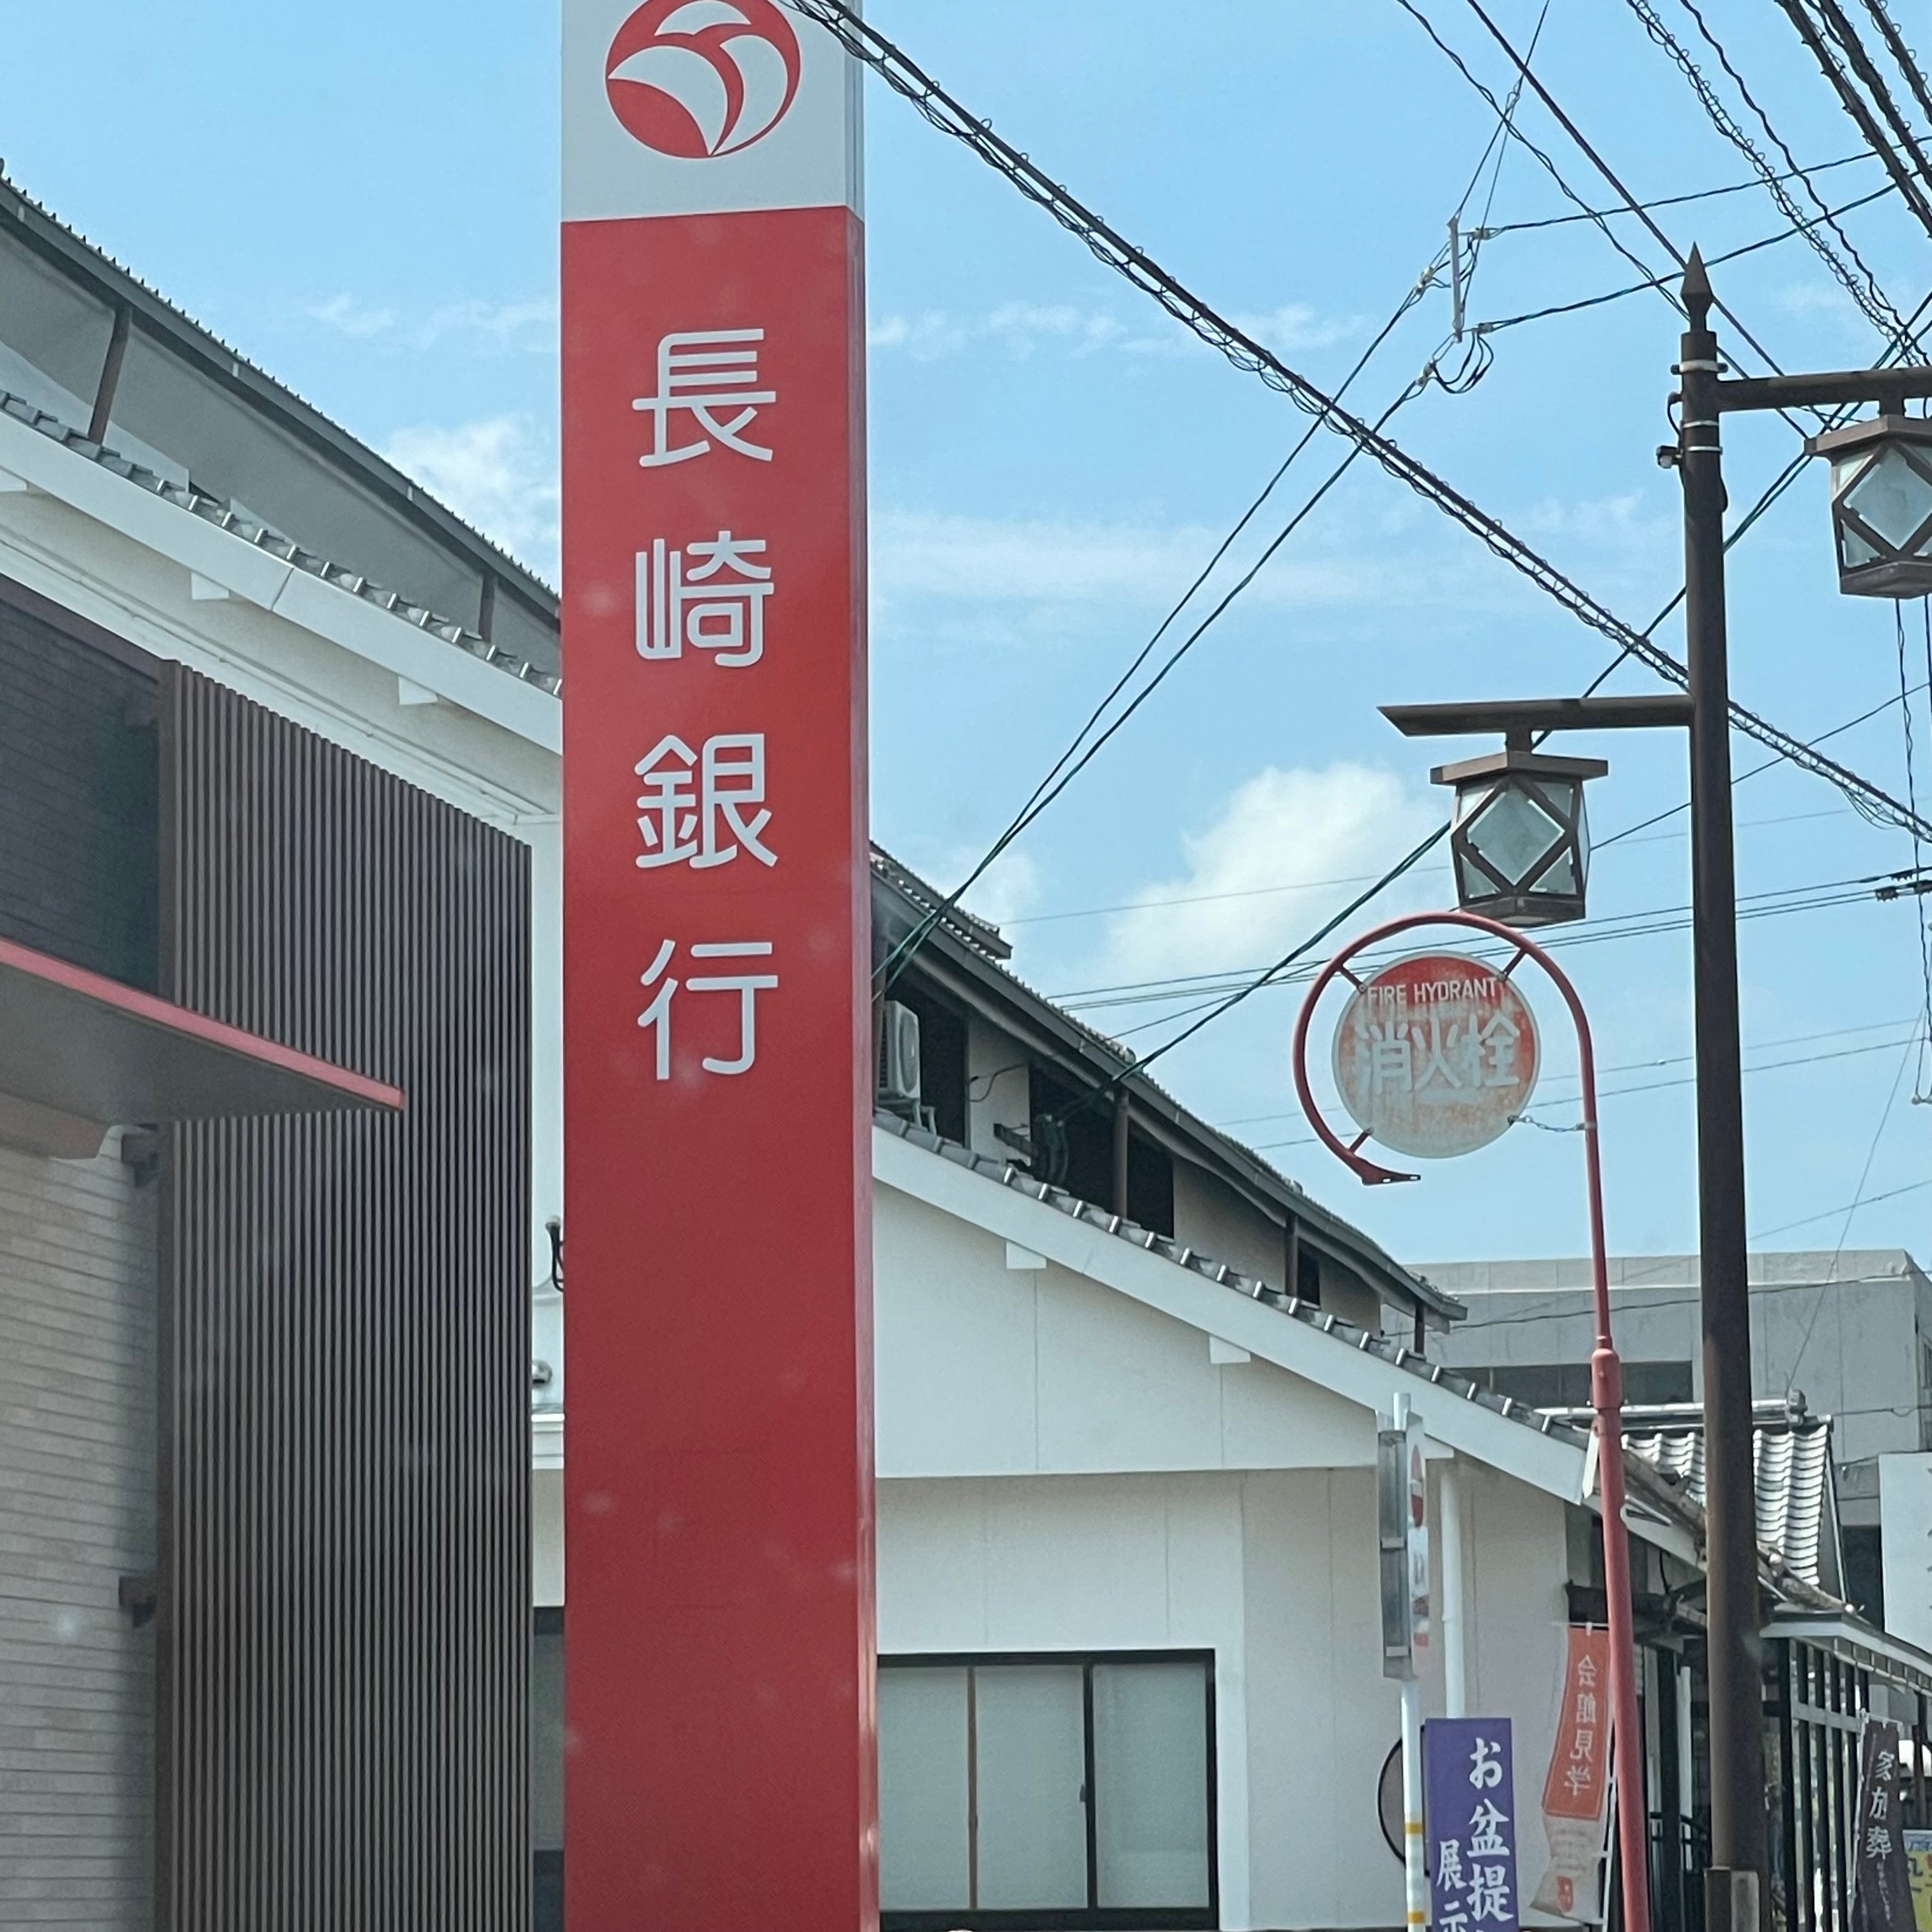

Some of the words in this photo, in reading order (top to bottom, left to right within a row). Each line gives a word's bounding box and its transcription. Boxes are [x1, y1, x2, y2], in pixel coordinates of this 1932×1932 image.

[632, 328, 779, 1080] 長崎銀行
[1354, 1010, 1521, 1094] 消火栓
[1367, 985, 1406, 1006] FIRE
[1413, 977, 1498, 1003] HYDRANT
[1467, 1737, 1514, 1932] お盆提
